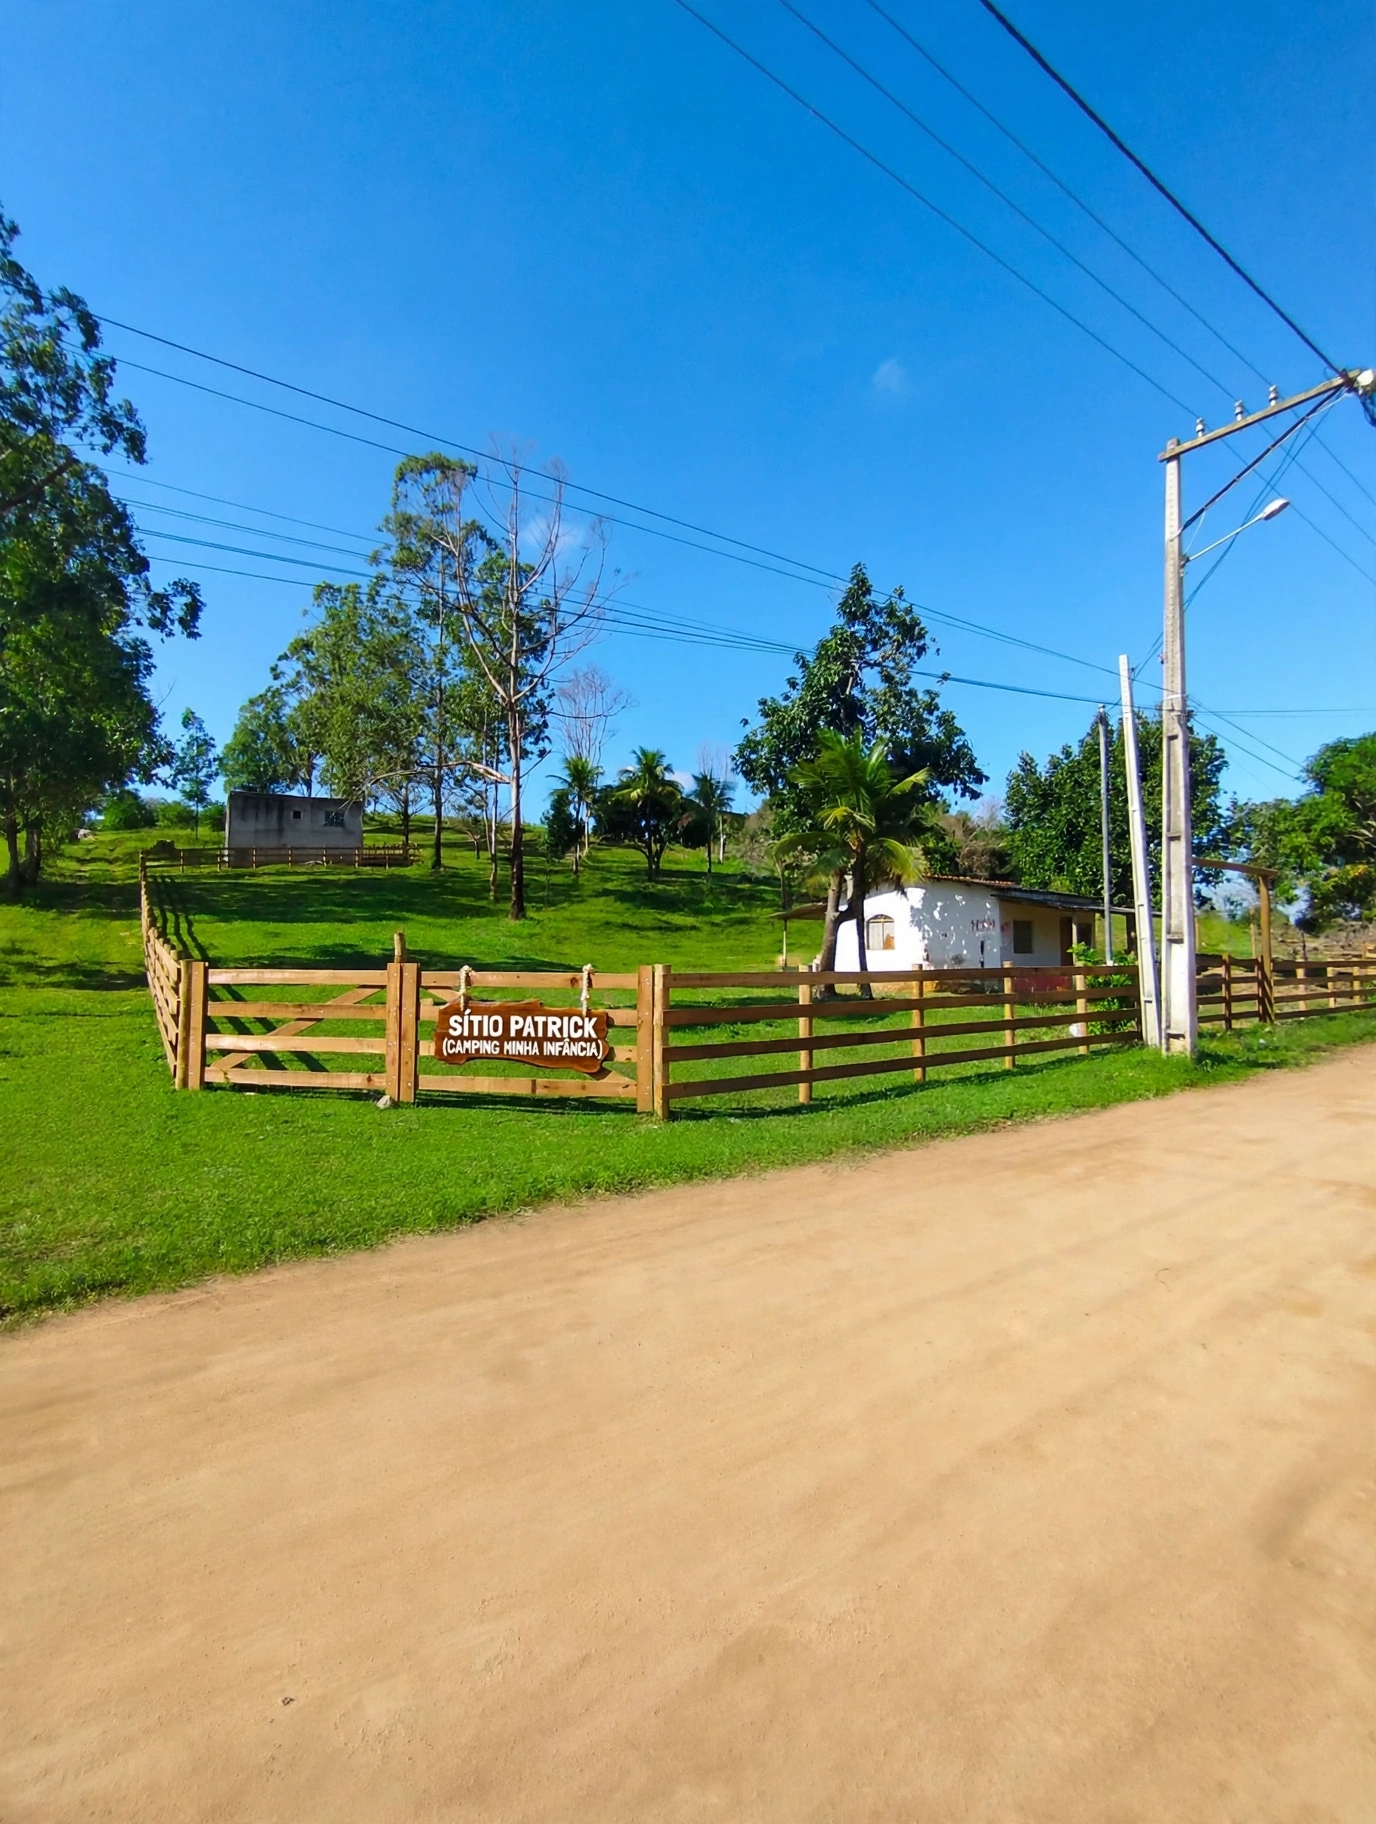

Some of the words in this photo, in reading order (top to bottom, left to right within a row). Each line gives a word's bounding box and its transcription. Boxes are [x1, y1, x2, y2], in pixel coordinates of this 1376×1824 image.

[449, 1009, 503, 1037] SÍTIO
[510, 1015, 598, 1038] PATRICK
[442, 1038, 500, 1056] (CAMPING
[504, 1040, 540, 1056] MINHA
[544, 1038, 603, 1059] INFÂNCIA)
